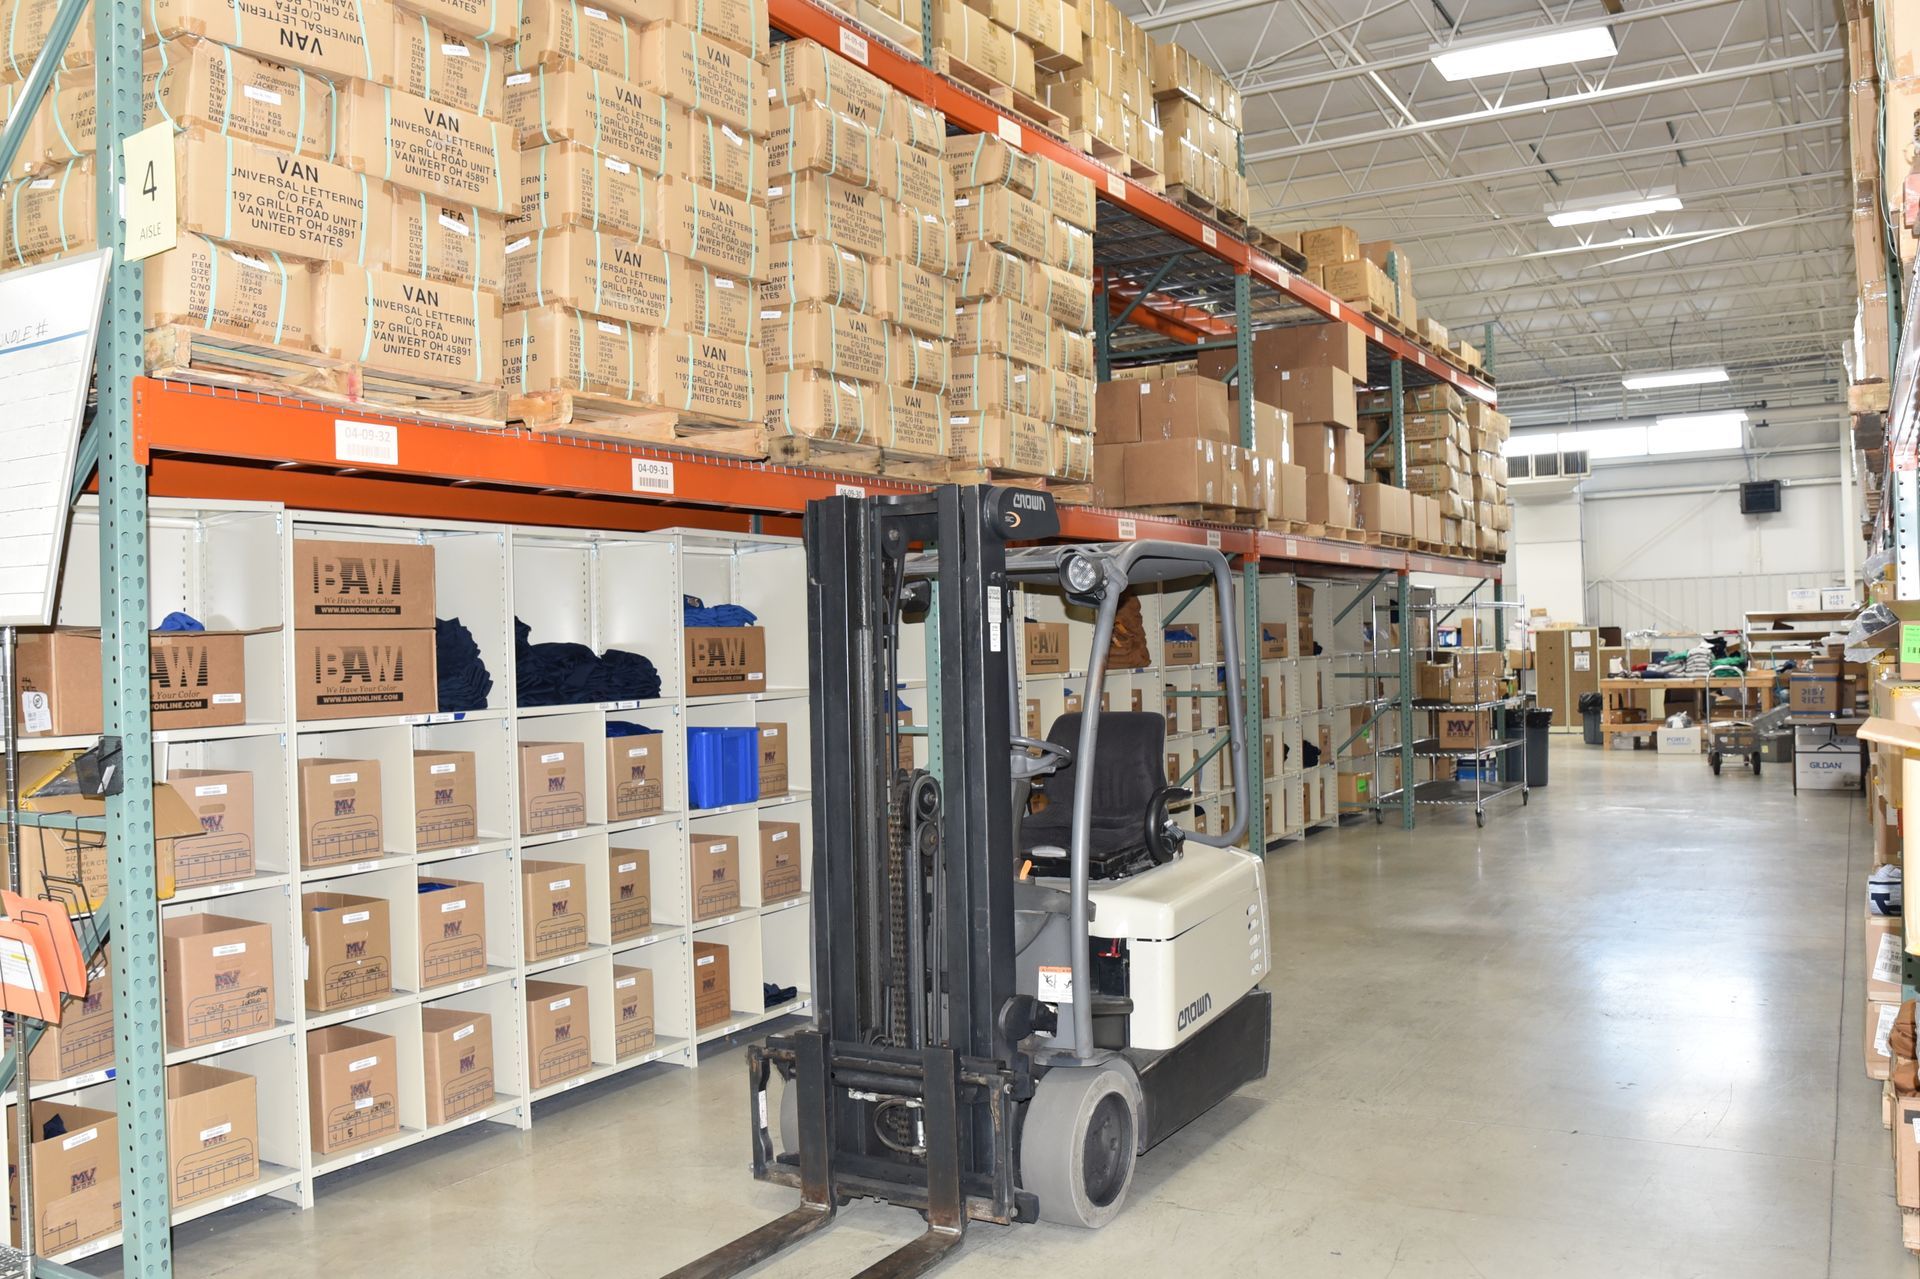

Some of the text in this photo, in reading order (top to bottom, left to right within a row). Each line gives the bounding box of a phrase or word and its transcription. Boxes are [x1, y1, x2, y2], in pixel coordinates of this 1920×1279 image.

[301, 9, 321, 21] C/O
[300, 20, 364, 46] UNIVERSAL
[444, 33, 465, 47] FFA
[280, 28, 323, 55] VAN
[707, 46, 730, 68] VAN
[210, 71, 225, 80] SIZE
[587, 91, 630, 115] UNVERSAL
[615, 86, 642, 109] VAN
[847, 101, 866, 120] VAN
[424, 108, 459, 133] VAN
[604, 116, 648, 140] GRILL ROAD
[617, 113, 645, 130] C/O FFA
[239, 124, 268, 137] VIETNAM
[611, 128, 632, 141] WERT
[635, 137, 645, 147] OH
[426, 139, 463, 157] C/O FFA
[601, 133, 658, 161] UNITED STATES
[410, 143, 437, 160] GRILL
[441, 153, 468, 168] ROAD
[471, 162, 490, 174] UNIT
[911, 152, 927, 168] VAN
[277, 157, 319, 183] VAN
[395, 150, 489, 184] VAN WERT OH 45891
[143, 160, 157, 202] 4
[405, 164, 480, 192] UNITED STATES
[1061, 171, 1074, 184] VAN
[277, 190, 323, 210] C/O FFA
[303, 185, 364, 209] LETTERING
[844, 191, 864, 207] VAN
[256, 196, 357, 228] GRILL ROAD UNIT
[710, 197, 734, 217] VAN
[1020, 202, 1034, 216] VAN
[238, 203, 355, 239] VAN WERT OH 45891
[139, 221, 162, 240] AISLE
[252, 218, 343, 248] UNITED STATES
[191, 261, 211, 269] ITEM
[615, 248, 642, 268] VAN
[192, 268, 209, 276] SIZE
[191, 282, 210, 290] C/NO
[915, 274, 930, 288] VAN
[249, 287, 262, 295] PCS
[403, 285, 439, 307] VAN
[602, 280, 665, 301] GRILL ROAD UNIT
[252, 310, 266, 318] KGS
[601, 298, 659, 317] UNITED STATES
[188, 312, 250, 328] MADE VIETNAM
[406, 316, 443, 331] C/O FFA
[1020, 310, 1033, 325] VAN
[389, 323, 472, 346] GRILL ROAD UNIT
[849, 319, 868, 334] VAN
[373, 330, 471, 357] VAN WERT OH 45891
[383, 344, 461, 366] UNITED STATES
[702, 344, 726, 362] VAN
[717, 398, 742, 409] STATES
[905, 395, 922, 409] VAN
[344, 427, 391, 442] 04-09-32
[1023, 422, 1036, 433] VAN
[638, 463, 669, 476] 04-09-31
[1013, 492, 1046, 512] CROWN
[313, 556, 401, 594] BAW
[321, 606, 396, 614] WWW.BAWONLINE.COM
[691, 638, 746, 667] BAW
[315, 645, 403, 684] BAW
[157, 691, 200, 700] Your Color
[322, 694, 398, 703] WWW.BAWONLINE.COM
[1447, 720, 1474, 732] MV
[631, 765, 646, 776] MV
[1809, 761, 1842, 769] GILDAN
[548, 776, 565, 787] MV
[434, 789, 453, 800] MV
[334, 798, 355, 811] MV
[712, 868, 726, 878] MV
[620, 884, 635, 895] MV
[552, 900, 568, 911] MV
[443, 920, 462, 934] MV
[346, 941, 366, 954] MV
[702, 978, 716, 987] MV
[622, 1004, 637, 1016] MV
[1177, 992, 1212, 1032] CROWN
[554, 1024, 570, 1036] MV
[460, 1054, 475, 1069] MV
[350, 1080, 371, 1096] MV
[71, 1167, 97, 1186] MV
